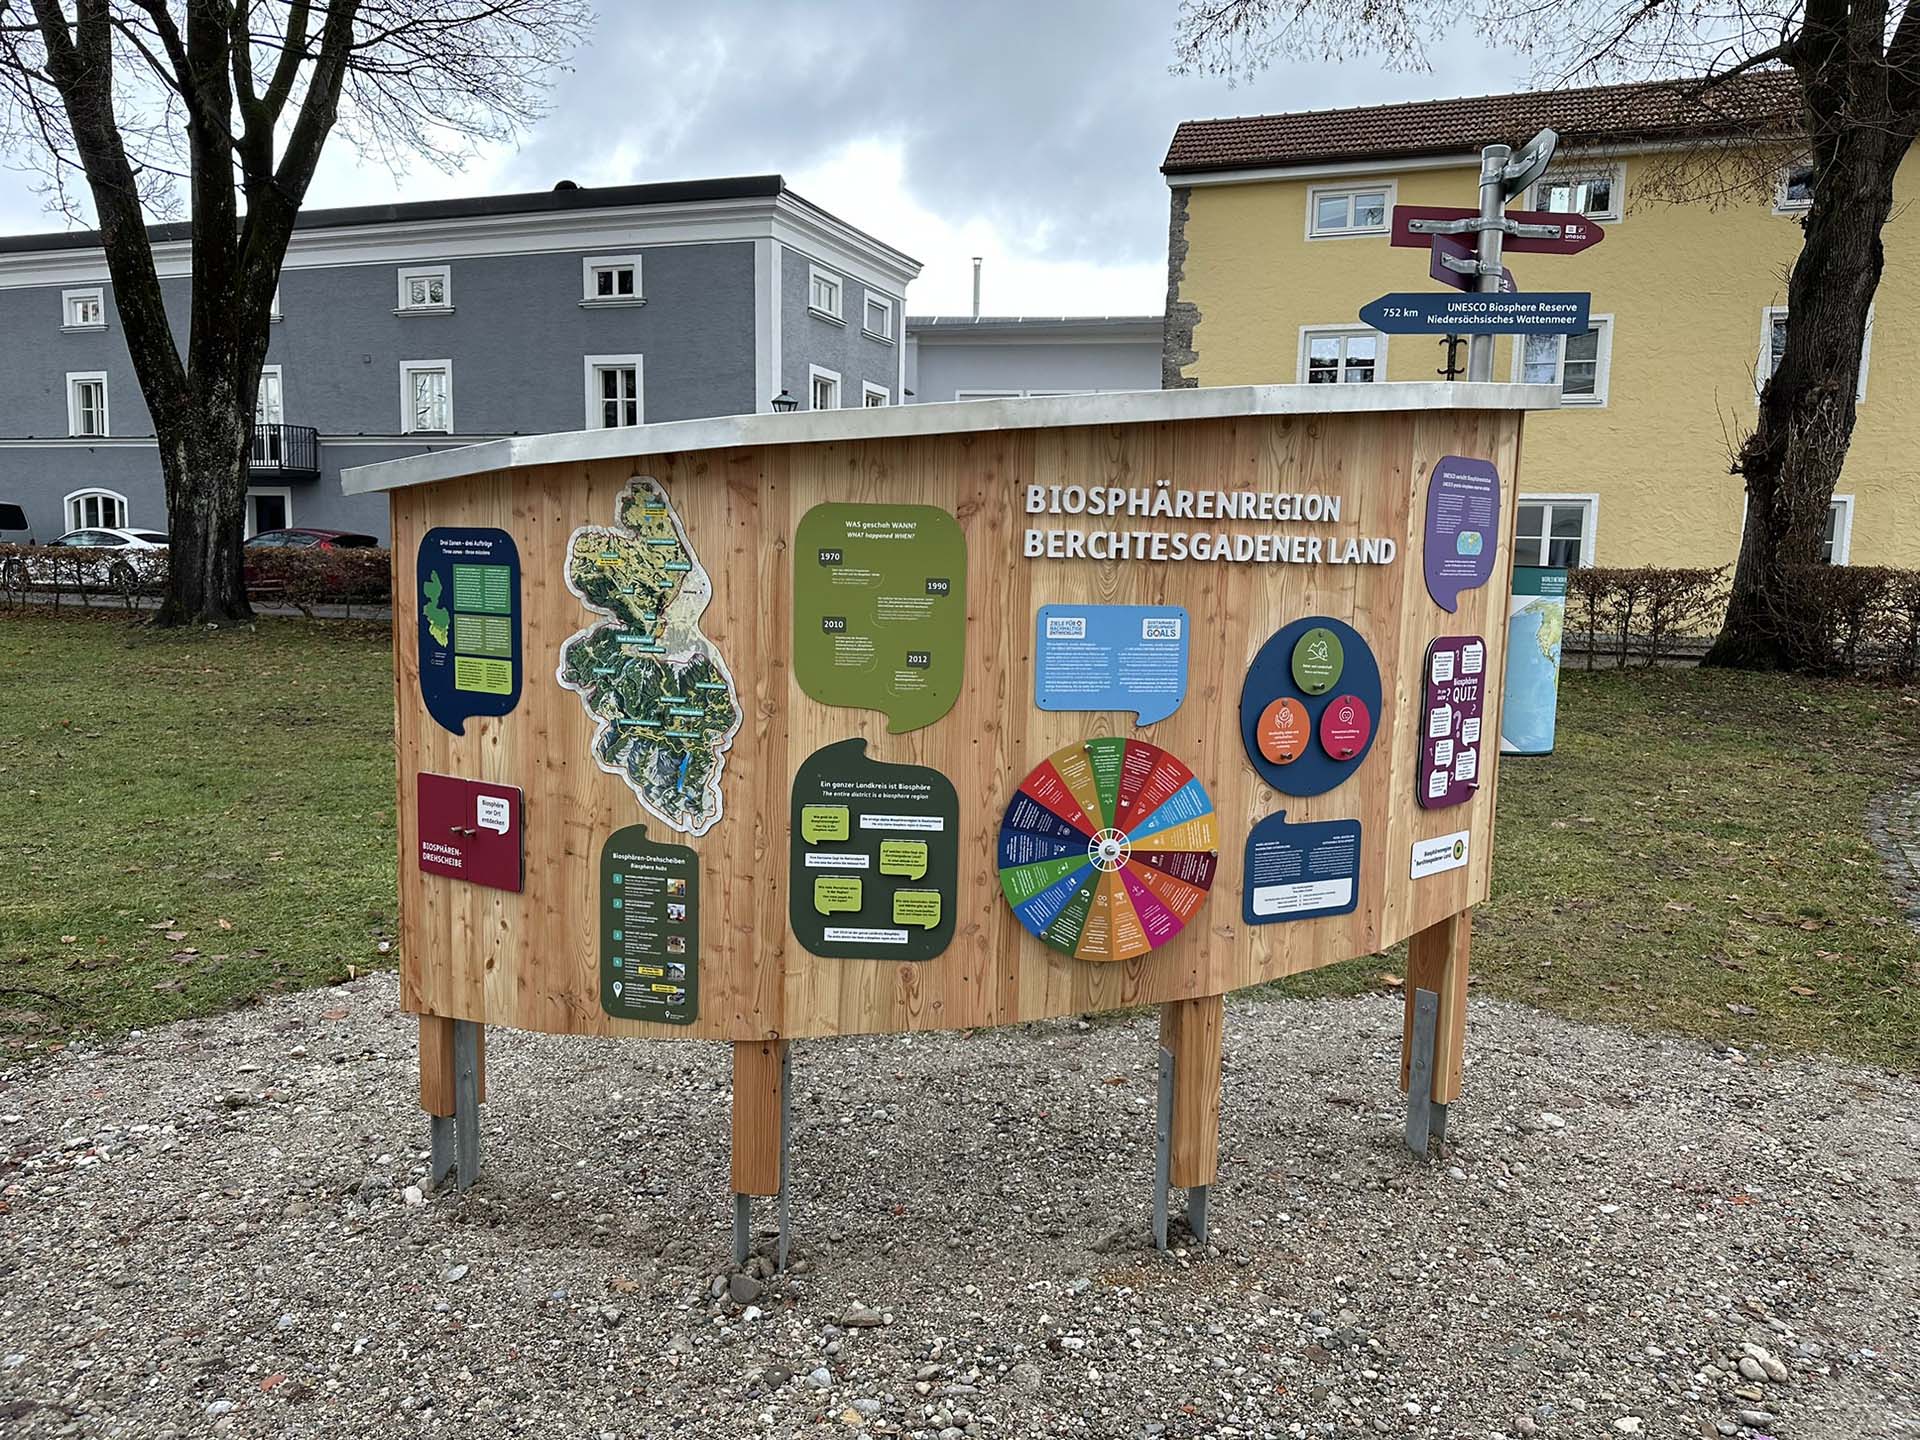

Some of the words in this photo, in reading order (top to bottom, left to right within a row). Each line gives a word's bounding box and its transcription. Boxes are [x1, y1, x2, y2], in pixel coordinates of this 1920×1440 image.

[1383, 308, 1400, 317] 752
[1403, 308, 1418, 317] km
[1447, 303, 1486, 312] UNESCO
[1488, 303, 1536, 314] Biosphere
[1538, 303, 1578, 312] Reserve
[1427, 314, 1514, 324] Niedersächsisches
[1516, 314, 1577, 324] Wattenmeer
[1025, 479, 1342, 522] BIOSPHÄRENREGION
[862, 522, 890, 530] geschah
[1024, 528, 1322, 565] BERCHTESGADENER
[1326, 536, 1397, 565] LAND
[820, 552, 840, 560] 1970
[928, 582, 947, 590] 1990
[824, 620, 844, 628] 2010
[1453, 686, 1477, 703] QUIZ
[898, 783, 931, 791] Biosphäre
[422, 841, 462, 856] BIOSPHÄREN-
[422, 852, 462, 867] DREHSCHEIBE
